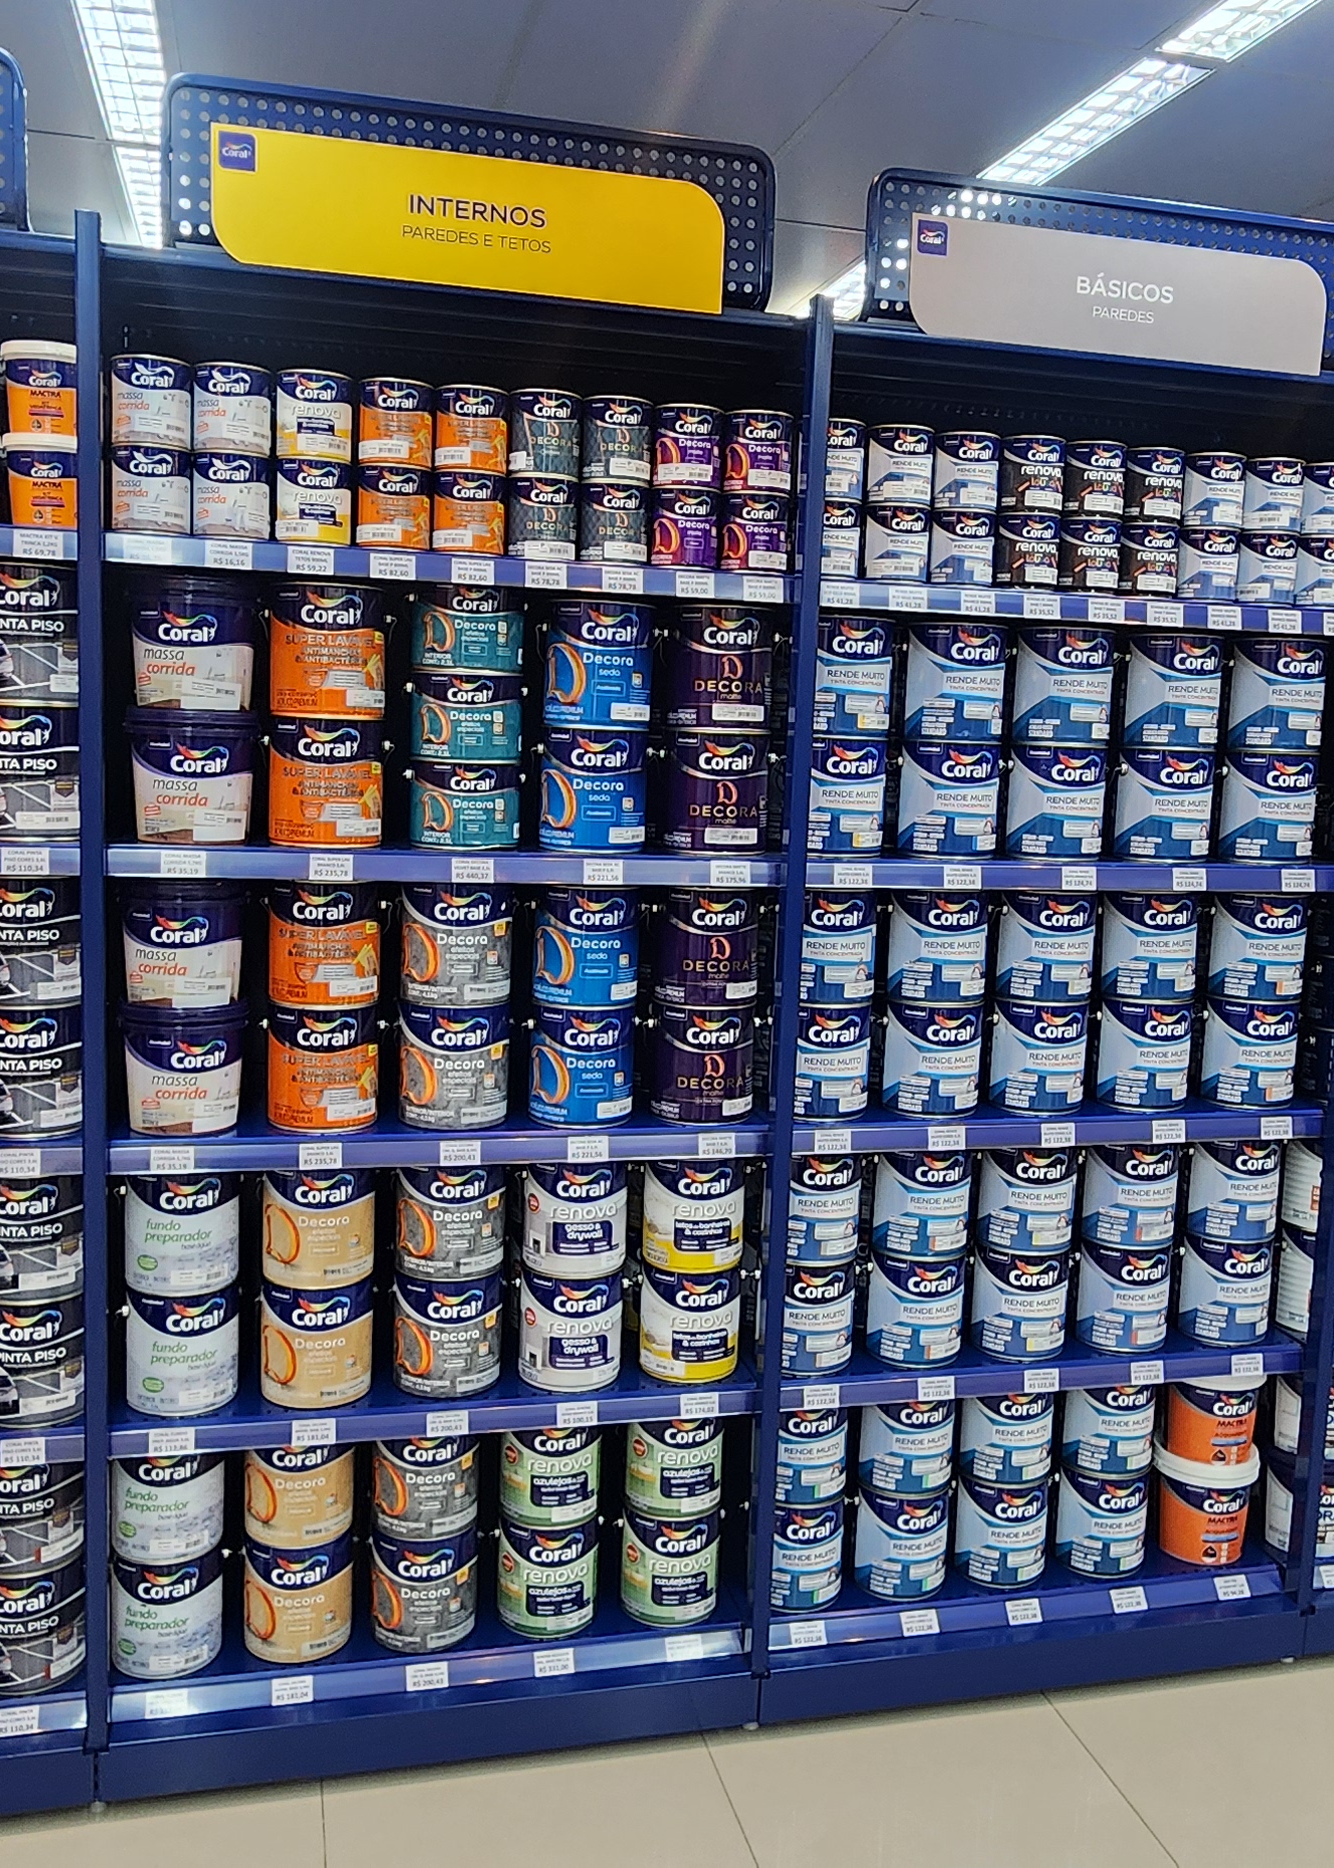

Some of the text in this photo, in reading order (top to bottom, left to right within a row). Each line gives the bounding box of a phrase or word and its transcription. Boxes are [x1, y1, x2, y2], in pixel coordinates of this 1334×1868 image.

[408, 194, 547, 229] INTERNOS
[402, 225, 552, 254] PAREDES E TETOS
[1075, 272, 1174, 304] BÁSICOS
[1092, 306, 1155, 325] PAREDES
[295, 384, 334, 401] Coral
[291, 405, 342, 418] renova
[679, 437, 711, 449] Decora
[1021, 465, 1061, 477] renova
[301, 605, 355, 625] Coral
[285, 634, 324, 645] SUPER
[582, 622, 632, 643] Coral
[703, 626, 753, 645] Coral
[832, 636, 879, 655] Coral
[583, 653, 634, 667] Decora
[827, 669, 885, 682] RENDE MUITO
[694, 680, 763, 694] DECORA
[170, 754, 221, 773] Coral
[942, 762, 987, 778] Coral
[152, 779, 198, 792] massa
[156, 793, 208, 807] corrida
[937, 793, 969, 802] RENDE
[434, 904, 484, 922] Coral
[811, 909, 859, 927] Coral
[437, 933, 488, 946] Decora
[806, 940, 866, 951] RENDE MUITO
[916, 1165, 961, 1183] Coral
[295, 1186, 347, 1204] Coral
[557, 1180, 606, 1198] Coral
[159, 1192, 214, 1210] Coral
[671, 1200, 736, 1217] renova
[910, 1194, 965, 1206] RENDE MUITO
[550, 1202, 618, 1220] renova
[146, 1218, 181, 1234] fundo
[298, 1215, 350, 1228] Decora
[144, 1230, 213, 1244] preparador
[1213, 1402, 1249, 1417] Coral
[1099, 1492, 1140, 1511] Coral
[1094, 1520, 1122, 1531] RENDE
[529, 1546, 579, 1564] Coral
[524, 1566, 588, 1584] renova
